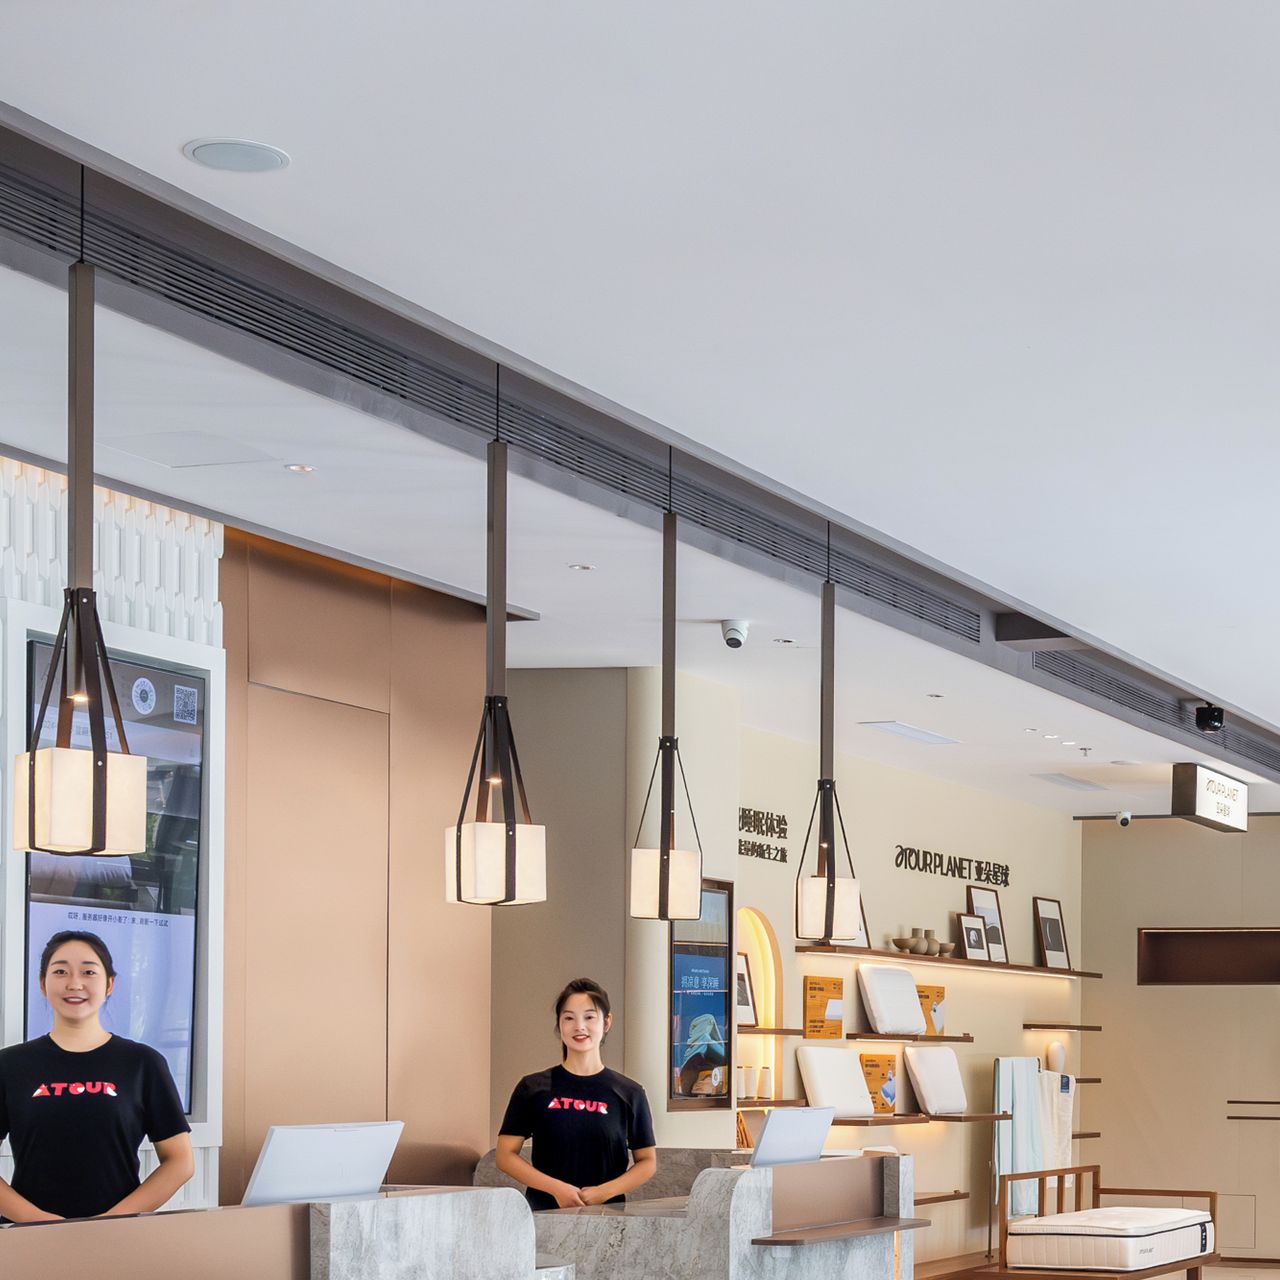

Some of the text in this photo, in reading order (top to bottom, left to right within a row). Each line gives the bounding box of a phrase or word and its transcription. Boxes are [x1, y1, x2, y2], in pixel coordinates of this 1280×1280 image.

[738, 807, 788, 839] 睡眠体验
[933, 852, 973, 880] PLANET
[974, 860, 1010, 887] 亚朵星球
[32, 1081, 117, 1097] ATOUR
[547, 1097, 608, 1114] ATOUR
